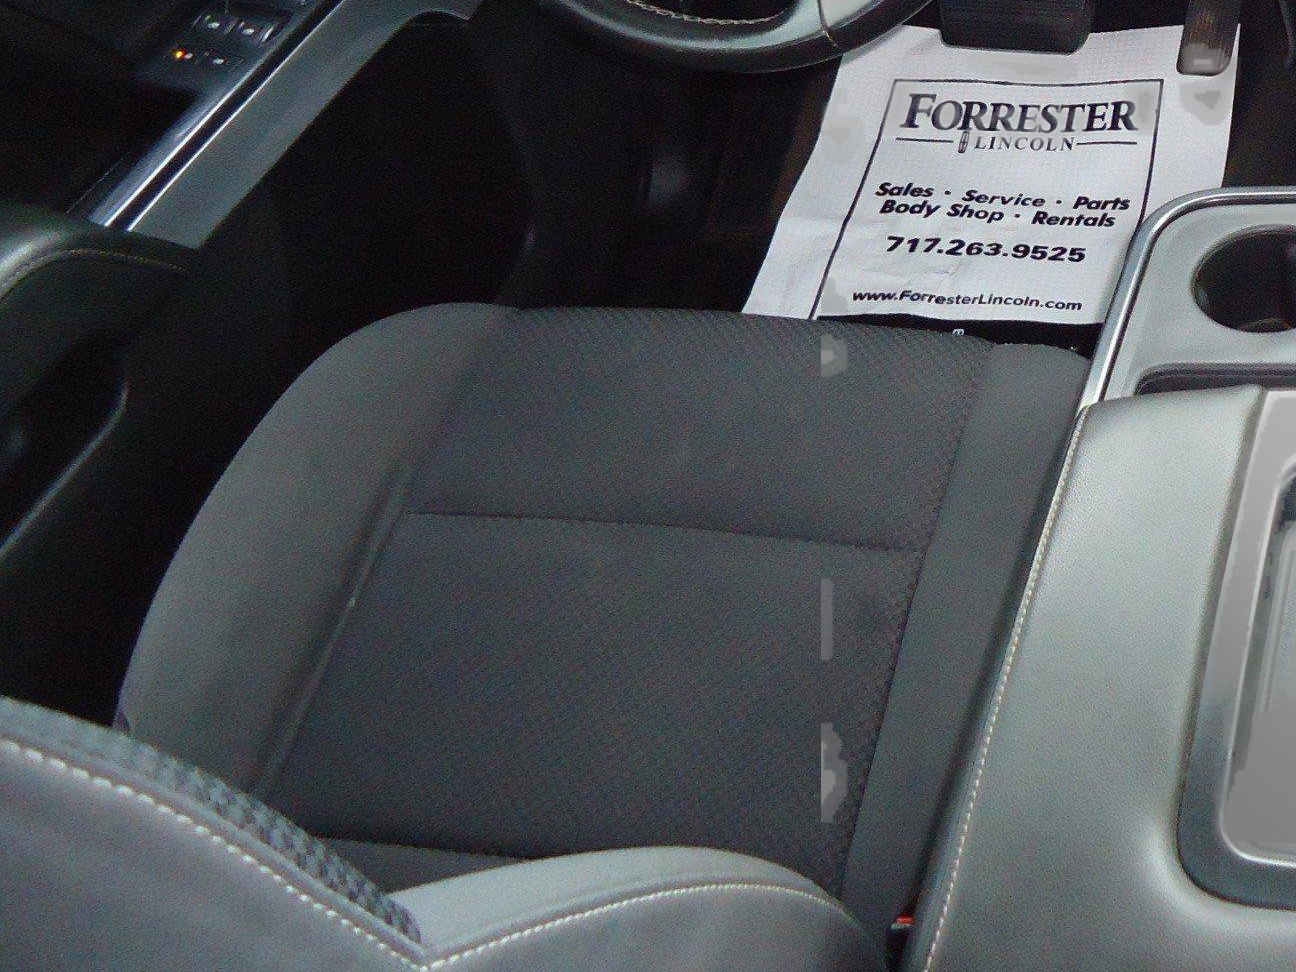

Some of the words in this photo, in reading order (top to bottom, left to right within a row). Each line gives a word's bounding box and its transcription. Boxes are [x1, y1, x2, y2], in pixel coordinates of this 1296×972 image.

[900, 93, 1138, 133] FORRESTER
[974, 136, 1076, 152] LINCOLN
[875, 181, 934, 198] Sales
[962, 189, 1046, 208] Service
[1073, 195, 1131, 211] Parts
[879, 199, 942, 219] Body
[946, 204, 1005, 224] Shop
[1031, 210, 1117, 228] Rentals
[886, 235, 1087, 263] 717.263.9525
[852, 289, 1084, 312] www.ForresterLincoln.com
